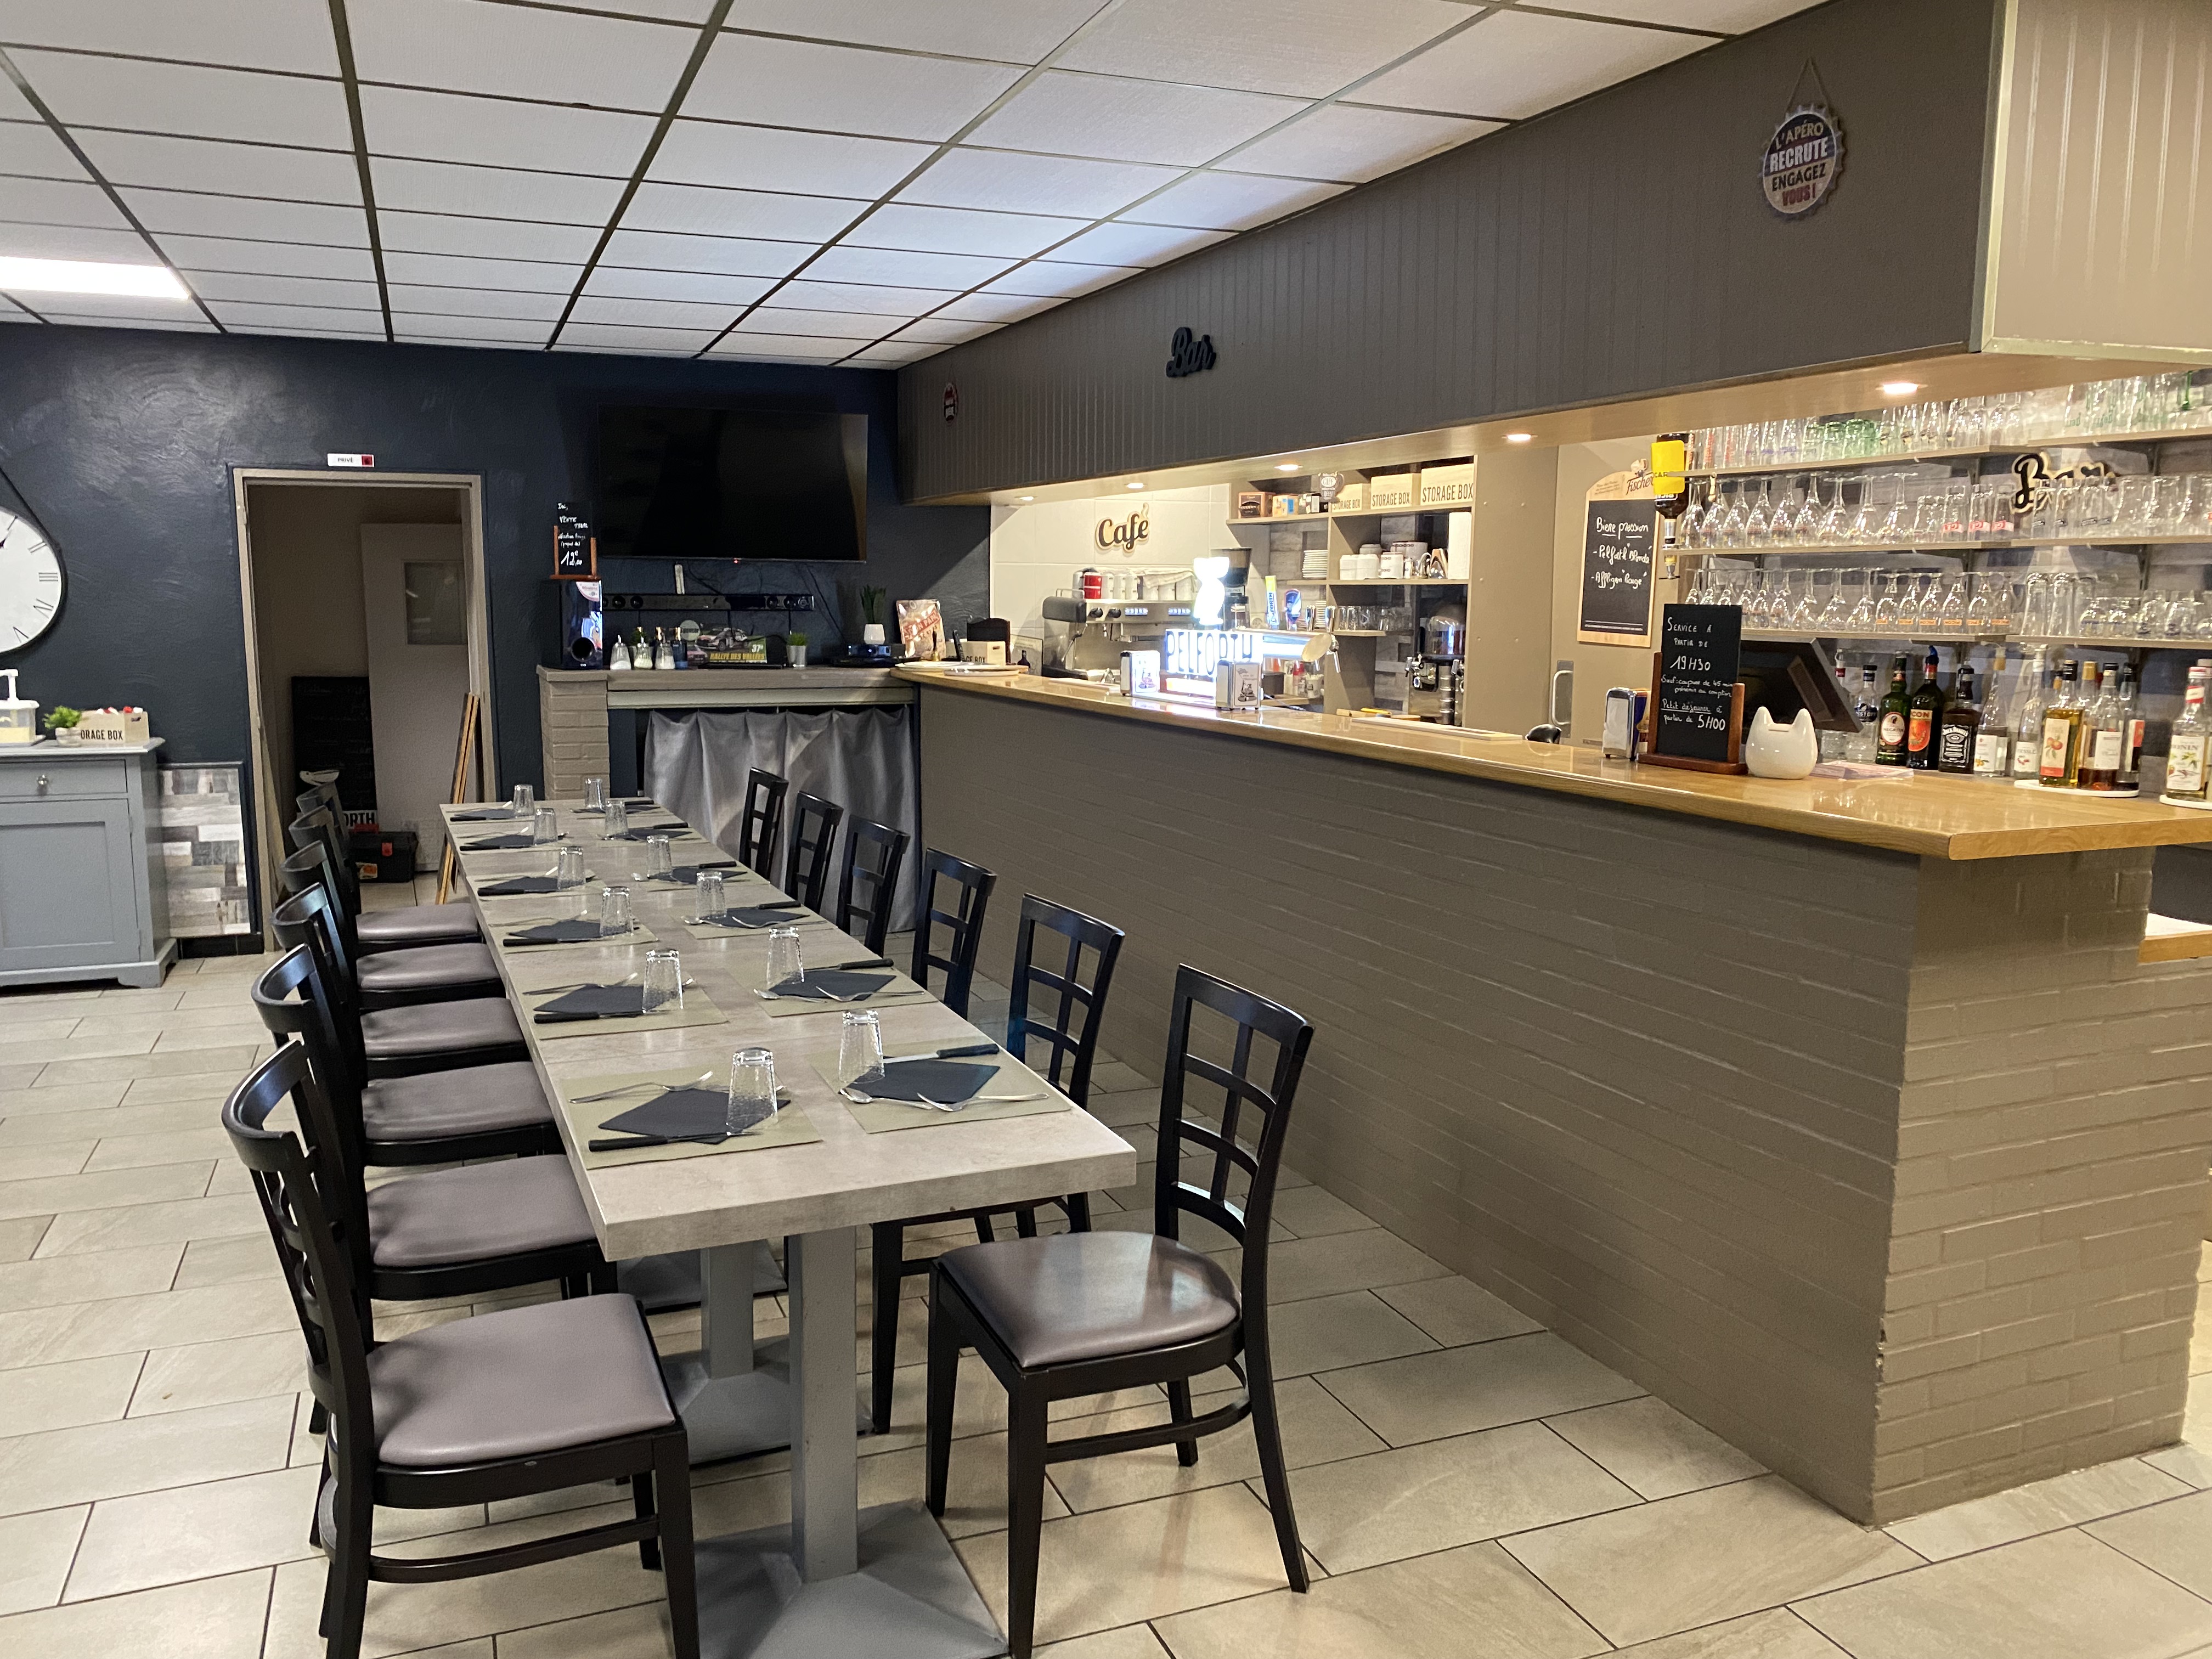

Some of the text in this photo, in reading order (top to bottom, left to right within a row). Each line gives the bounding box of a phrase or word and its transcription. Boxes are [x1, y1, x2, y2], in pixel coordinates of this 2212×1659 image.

[1775, 119, 1824, 150] L'APÉRO
[1770, 137, 1828, 173] RECRUTE
[1772, 162, 1827, 191] ENGAGEZ
[1166, 326, 1216, 377] Bar
[1626, 472, 1654, 495] Fischer
[1372, 492, 1410, 507] STORAGE BOX
[1422, 483, 1474, 503] STORAGE BOX
[1333, 499, 1361, 510] STORAGE BOX
[1618, 522, 1649, 540] pression
[1670, 656, 1711, 671] 19H30
[1662, 698, 1678, 709] Petit
[1663, 713, 1683, 725] partir
[1697, 714, 1726, 731] 5H00
[81, 730, 123, 740] ORAGE BOX
